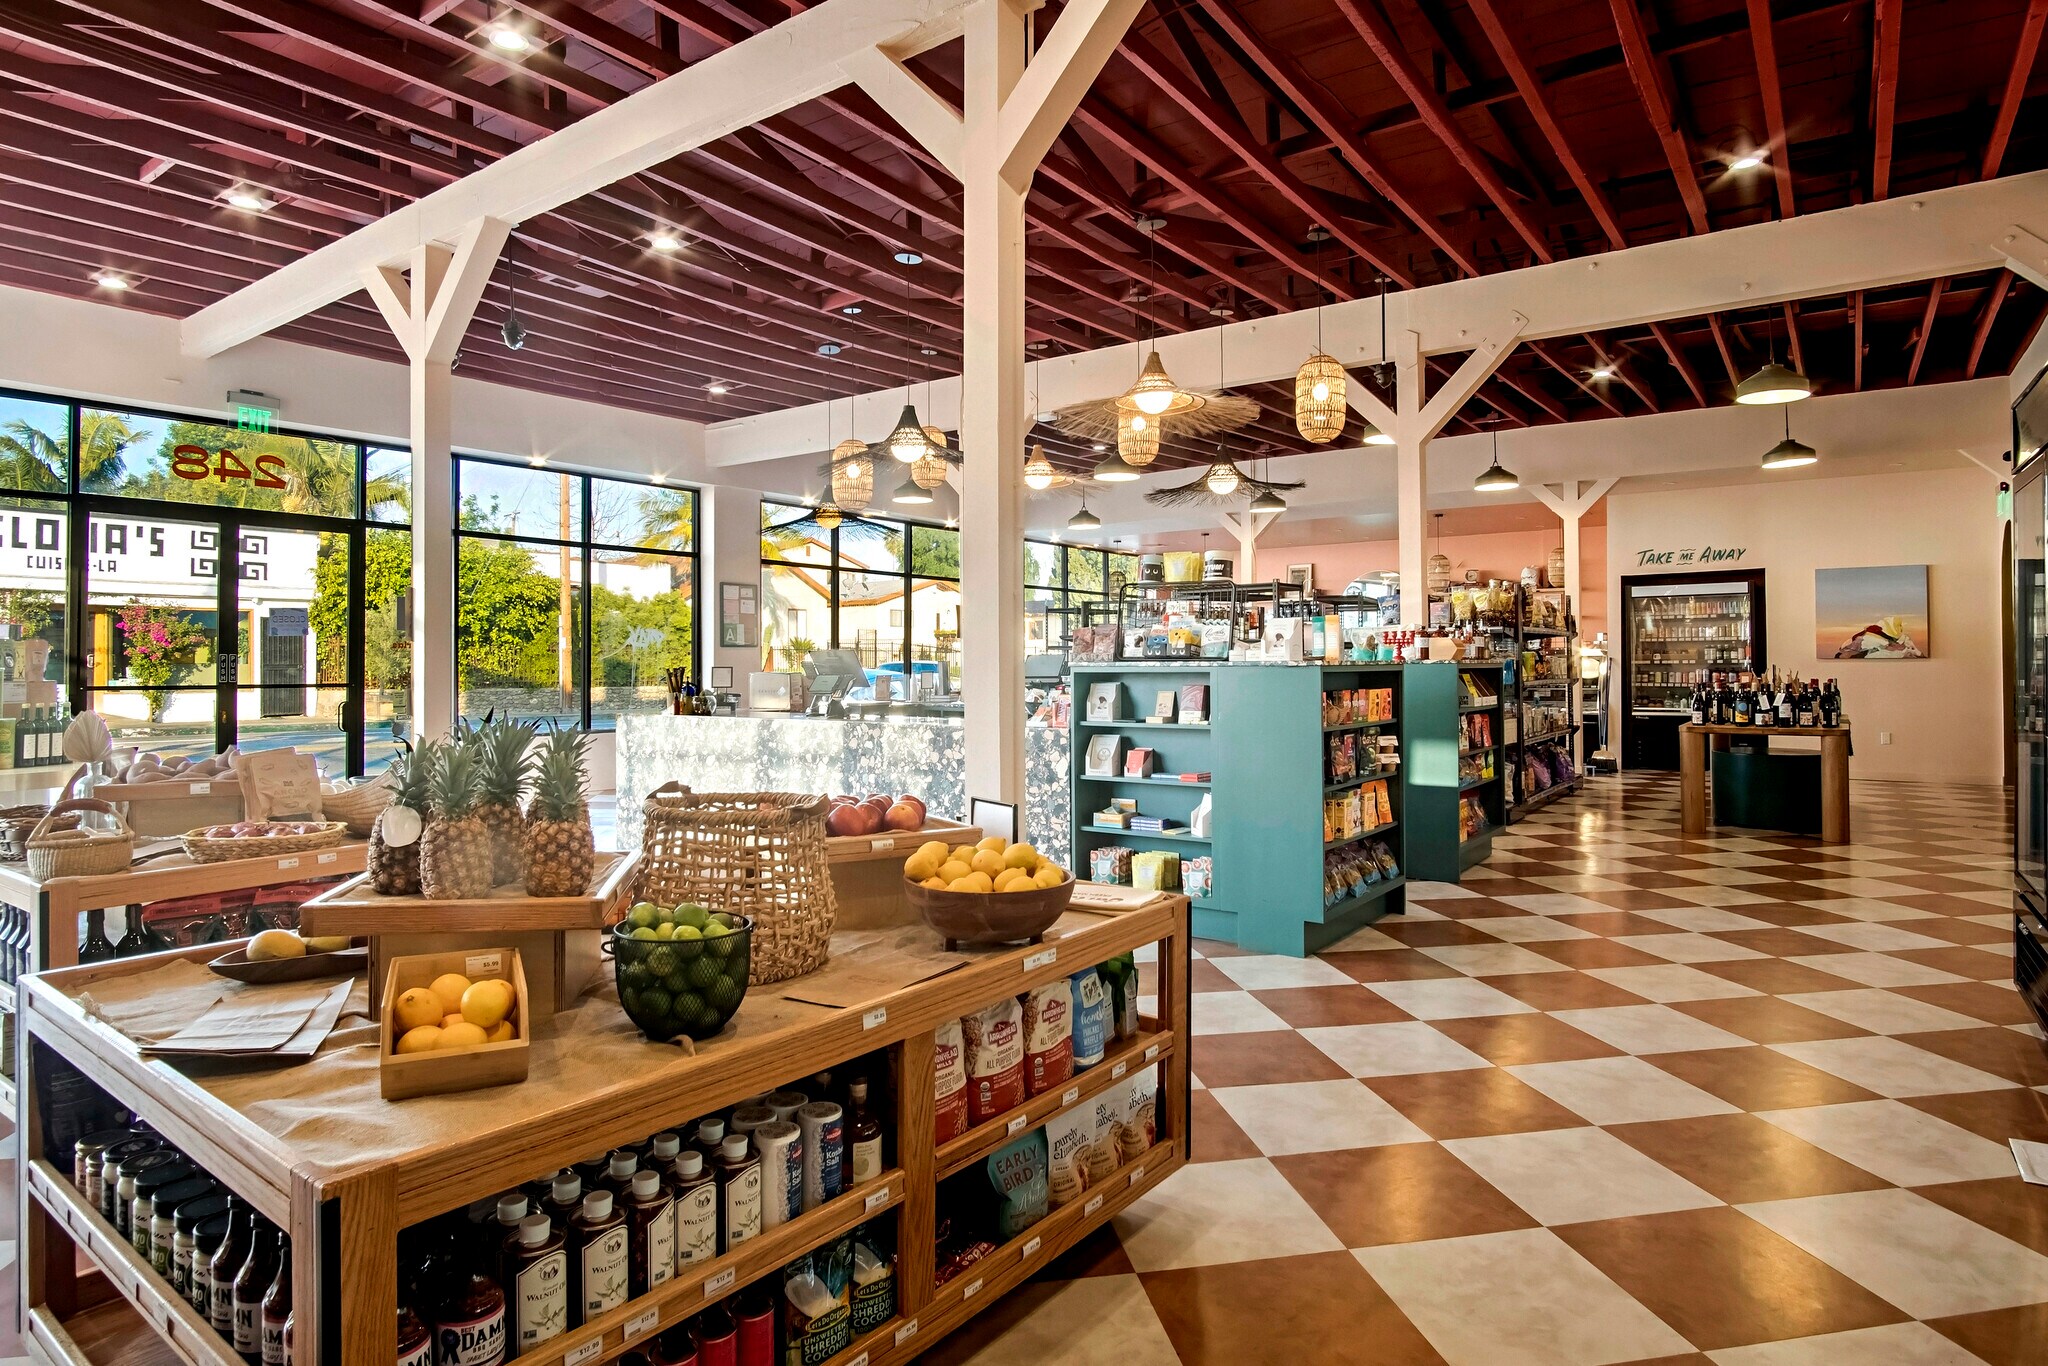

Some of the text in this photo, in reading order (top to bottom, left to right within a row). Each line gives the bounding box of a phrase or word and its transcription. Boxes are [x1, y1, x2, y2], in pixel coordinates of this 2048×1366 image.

[238, 406, 272, 434] EXIT
[0, 515, 165, 558] LOIA'S
[1637, 546, 1747, 567] TAKE ME AWAY
[725, 628, 735, 641] A
[997, 1045, 1014, 1057] ORGANIC
[986, 1059, 995, 1070] ALL
[1054, 1128, 1078, 1152] purely
[995, 1143, 1038, 1175] EARLY
[1003, 1167, 1035, 1193] BIRD
[683, 1215, 711, 1226] WALNUT
[592, 1261, 621, 1275] WALNUT
[716, 1270, 734, 1285] $12.99
[526, 1288, 558, 1302] WALNUT
[857, 1287, 870, 1296] Let's
[870, 1283, 879, 1292] Do
[641, 1312, 656, 1324] $12.99
[807, 1320, 822, 1331] Let's
[821, 1315, 831, 1324] Do
[461, 1326, 475, 1334] BEST
[804, 1324, 849, 1356] SHREDDE
[472, 1343, 486, 1353] BBQ
[579, 1340, 600, 1356] $12.99
[804, 1334, 849, 1364] COCONU
